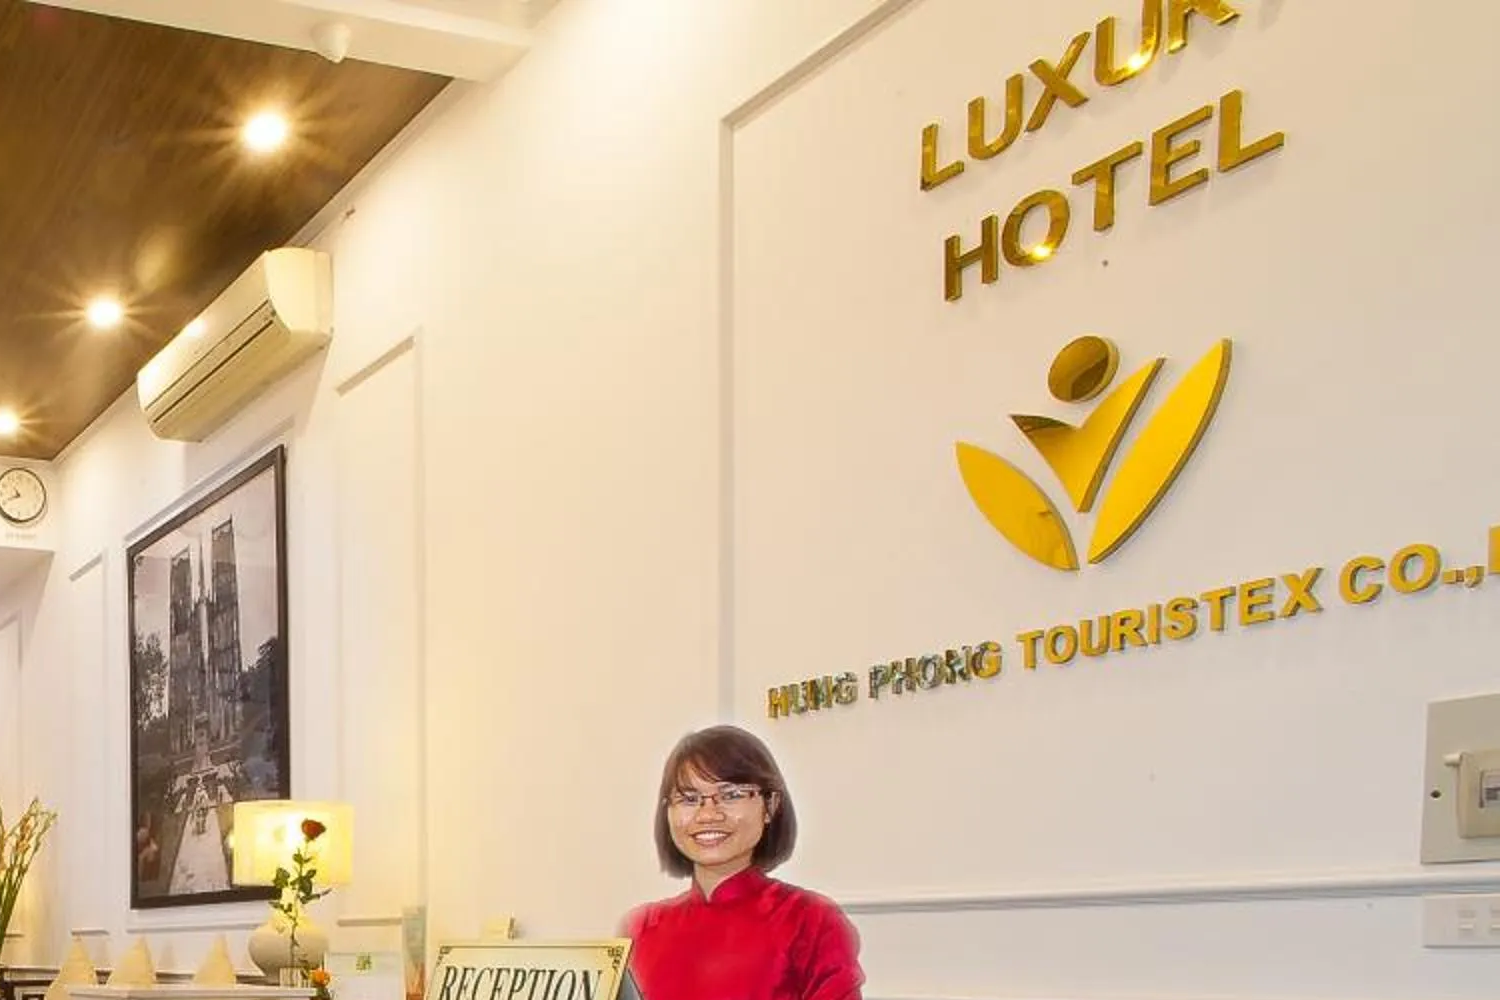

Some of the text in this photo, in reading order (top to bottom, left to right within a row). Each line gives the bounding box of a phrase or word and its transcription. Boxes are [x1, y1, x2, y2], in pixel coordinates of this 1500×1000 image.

[943, 88, 1285, 302] HOTEL
[766, 522, 1500, 720] HUNG PHONG TOURISTEX CO.,
